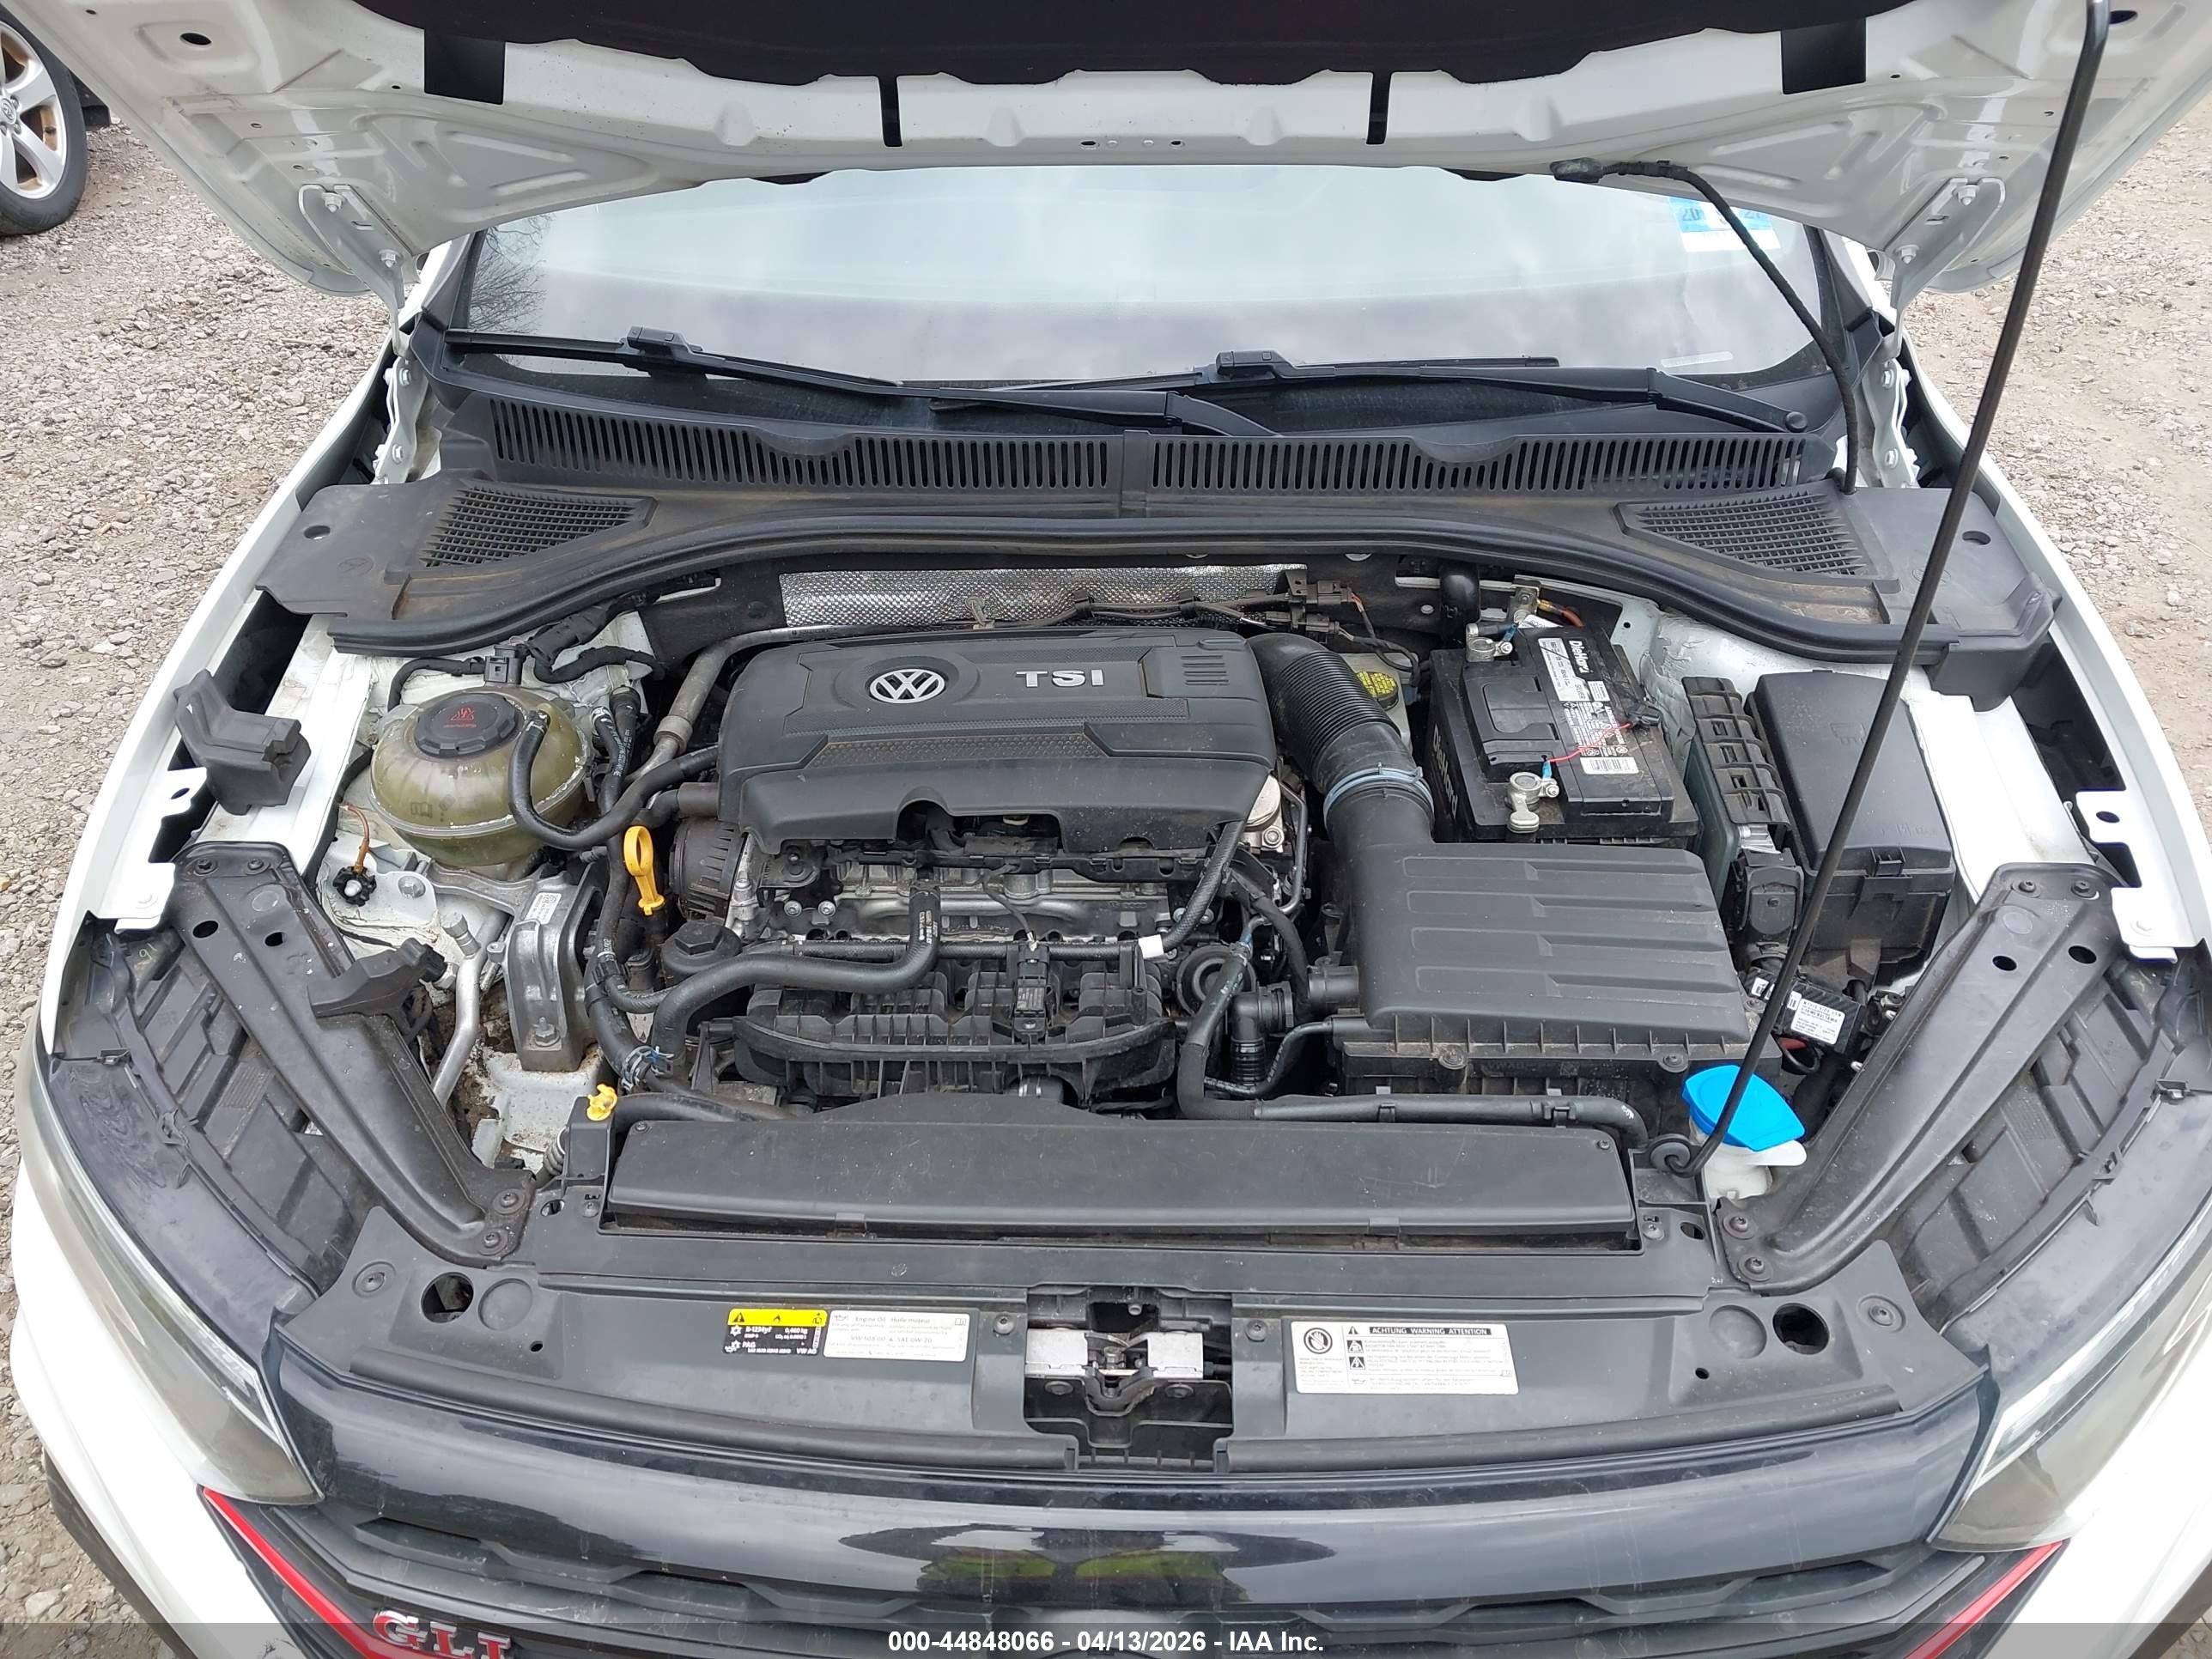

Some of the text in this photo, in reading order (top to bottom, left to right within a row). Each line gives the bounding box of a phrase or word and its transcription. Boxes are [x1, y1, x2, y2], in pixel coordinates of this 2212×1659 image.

[1016, 669, 1104, 688] TSI
[1449, 1328, 1487, 1336] ATTENTION
[373, 1609, 512, 1659] GLI
